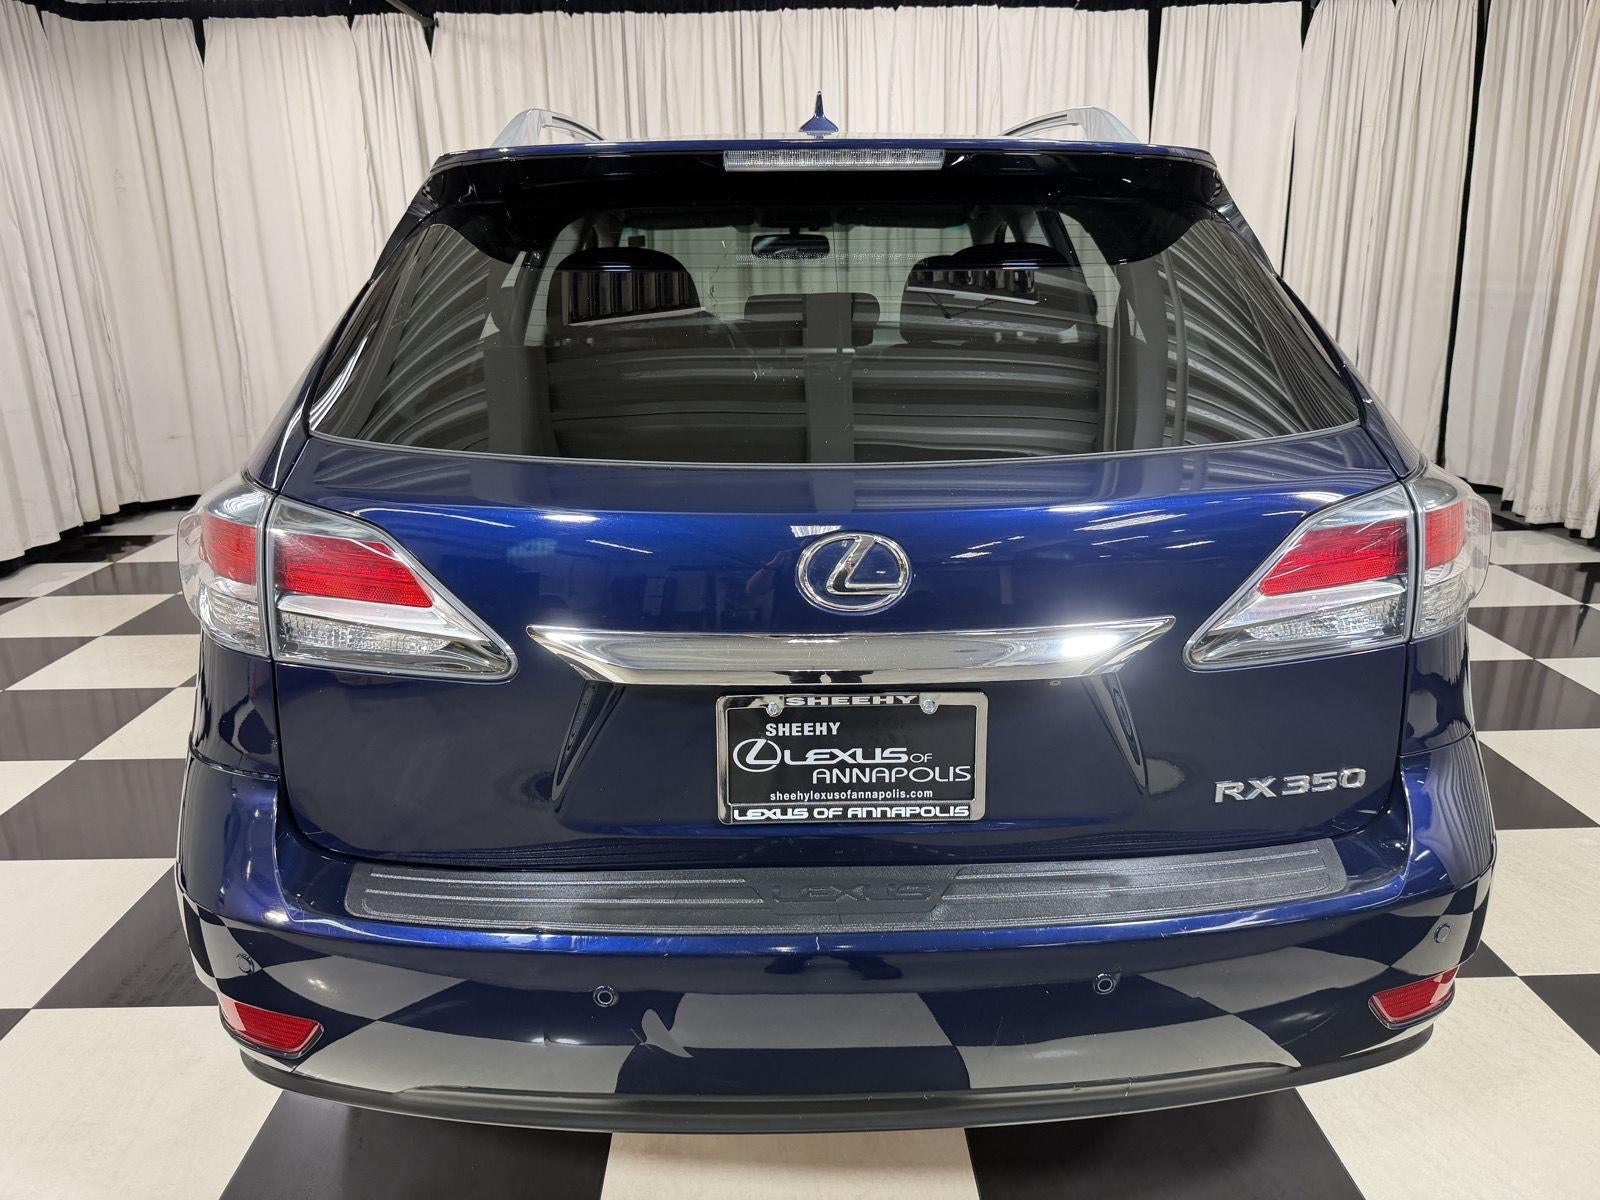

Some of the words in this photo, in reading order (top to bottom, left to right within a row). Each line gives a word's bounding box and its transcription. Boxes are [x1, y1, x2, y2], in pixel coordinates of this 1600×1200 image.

[785, 694, 918, 706] SHEEHY
[765, 722, 841, 737] SHEEHY
[783, 747, 908, 765] LEXUS
[909, 752, 933, 763] OF
[812, 765, 972, 784] ANNAPOLIS
[769, 788, 933, 802] sheehylexusofannapolis.com
[733, 806, 809, 821] LEXUS
[813, 806, 843, 819] OF
[847, 805, 969, 819] ANNAPOLIS
